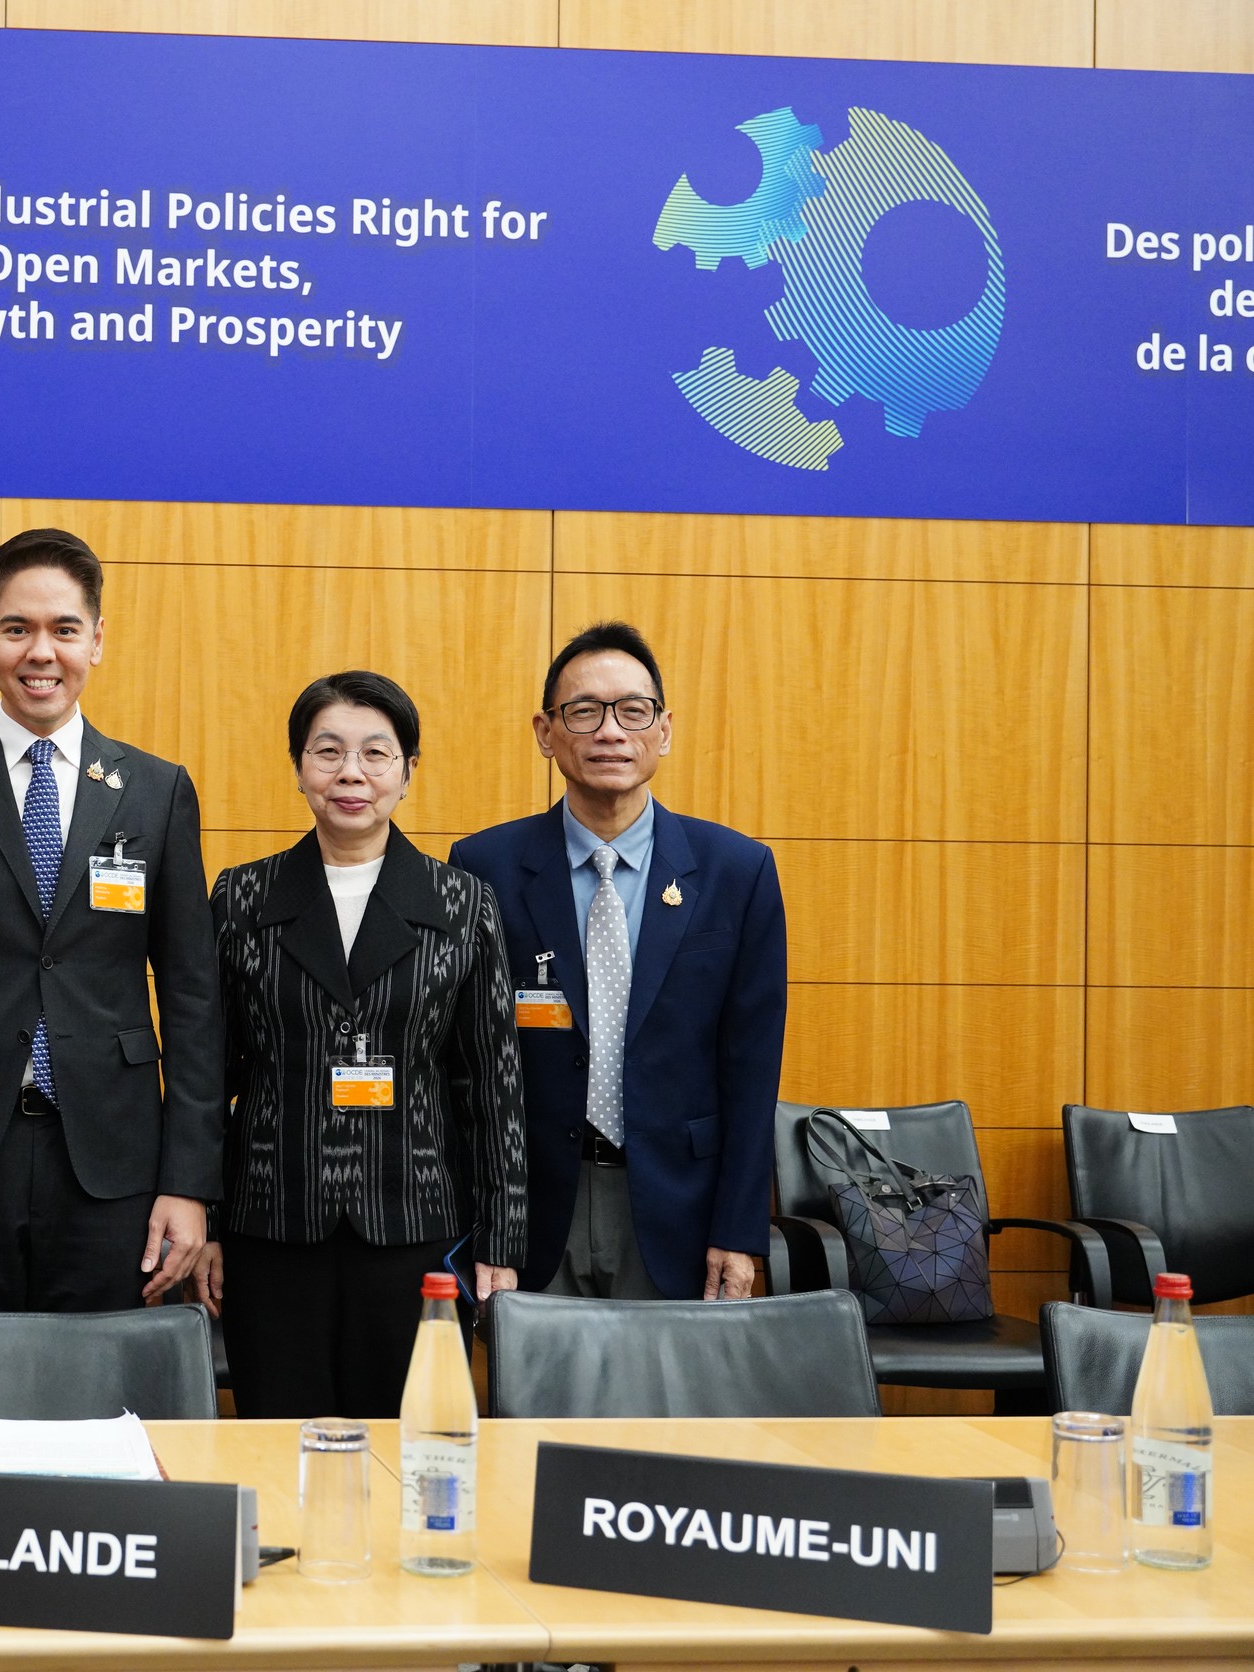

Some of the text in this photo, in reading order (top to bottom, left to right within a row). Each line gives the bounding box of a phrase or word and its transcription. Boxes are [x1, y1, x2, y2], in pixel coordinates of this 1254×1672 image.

[168, 192, 336, 234] Policies
[352, 197, 470, 248] Right
[482, 200, 548, 240] for
[1106, 222, 1180, 261] Des
[116, 248, 312, 296] Markets,
[70, 303, 153, 343] and
[171, 306, 403, 360] Prosperity
[1136, 332, 1186, 371] de
[1199, 333, 1233, 372] la
[582, 1497, 936, 1573] ROYAUME-UNI
